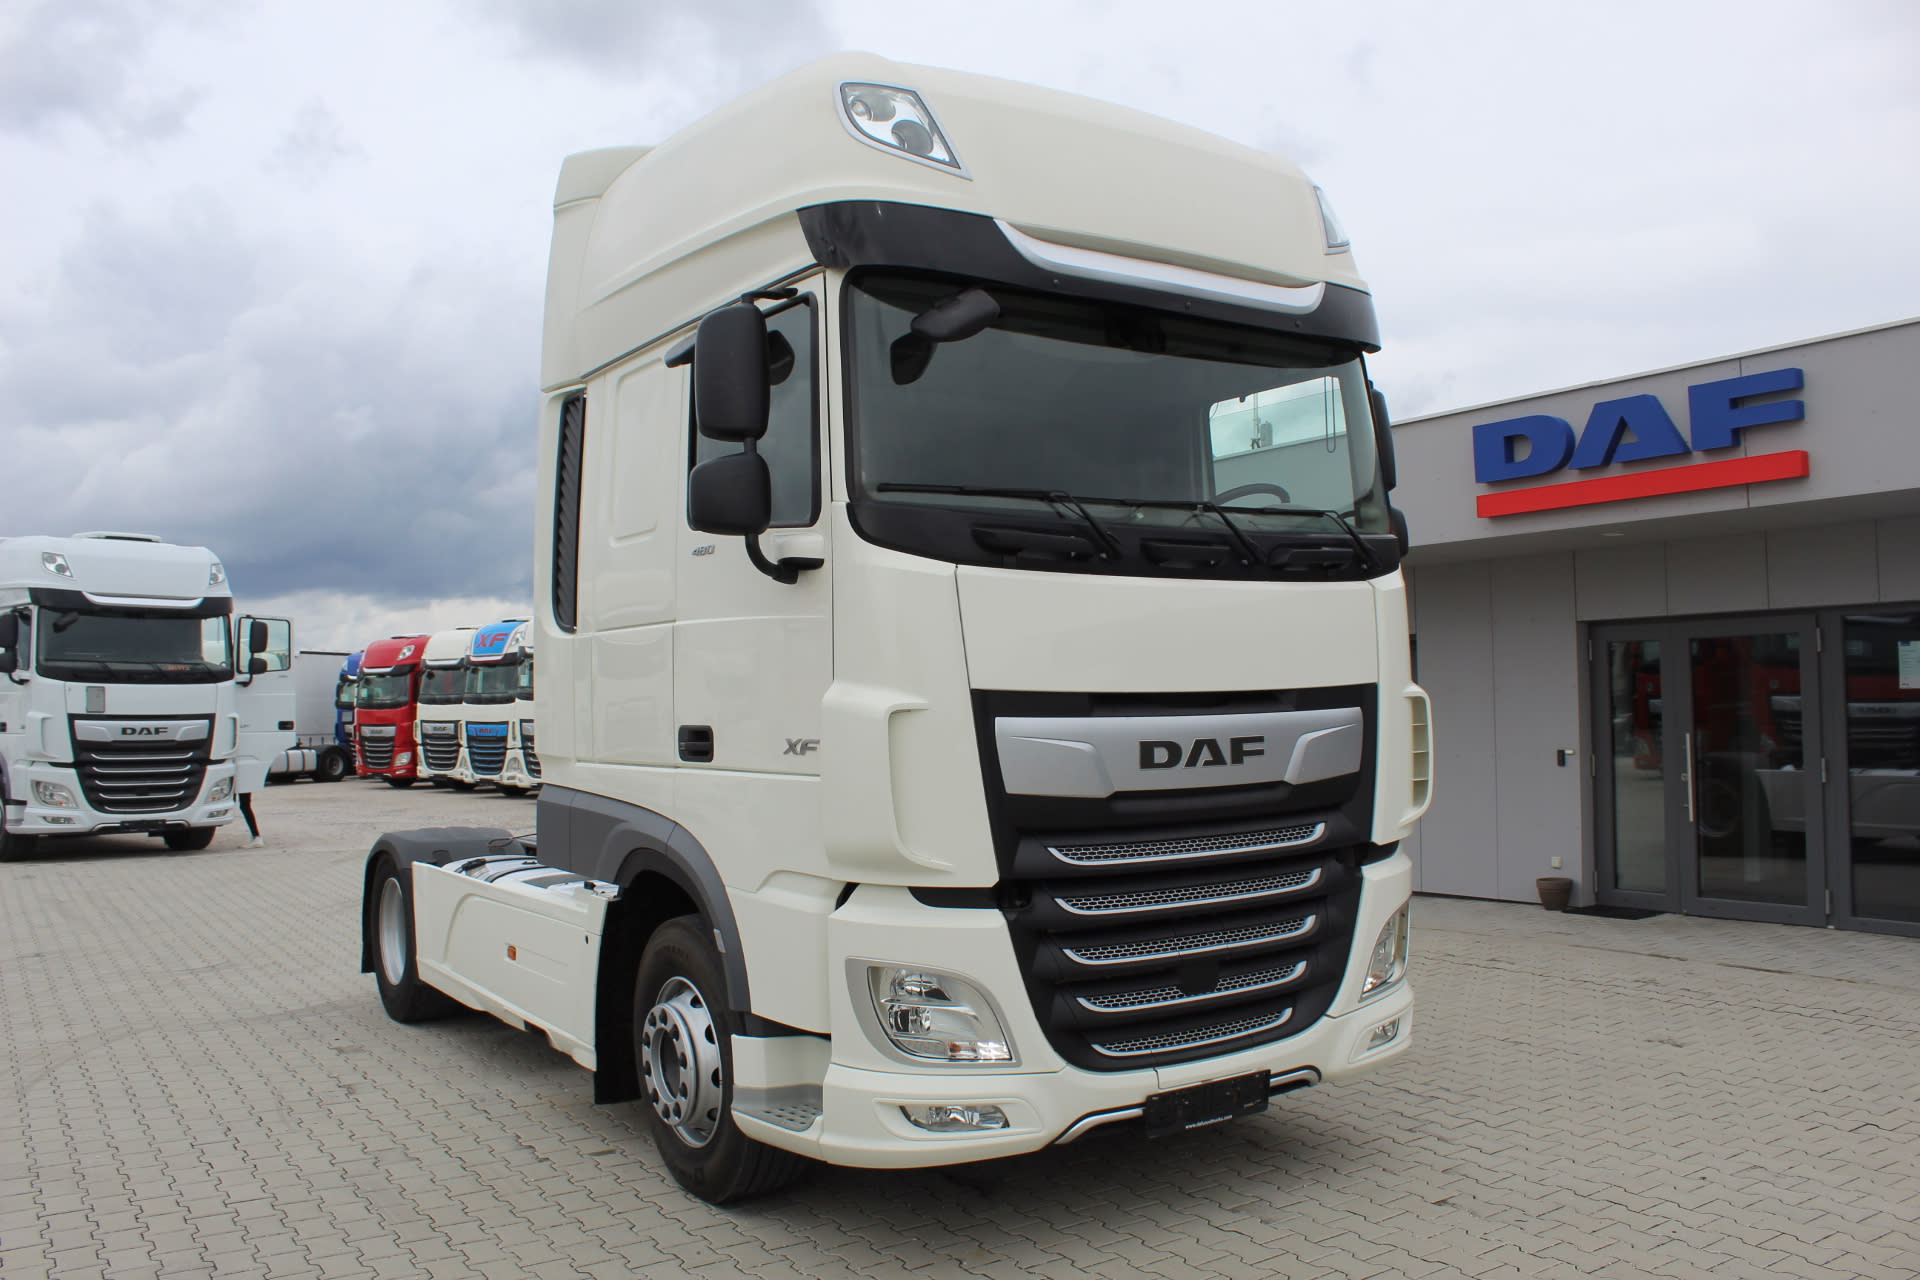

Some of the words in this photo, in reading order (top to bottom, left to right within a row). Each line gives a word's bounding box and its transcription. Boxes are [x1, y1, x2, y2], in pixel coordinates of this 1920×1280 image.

[1473, 368, 1804, 483] DAF
[692, 544, 716, 556] 480
[476, 633, 509, 648] XF
[121, 726, 169, 736] DAF
[783, 738, 821, 756] XF
[1138, 735, 1265, 770] DAF
